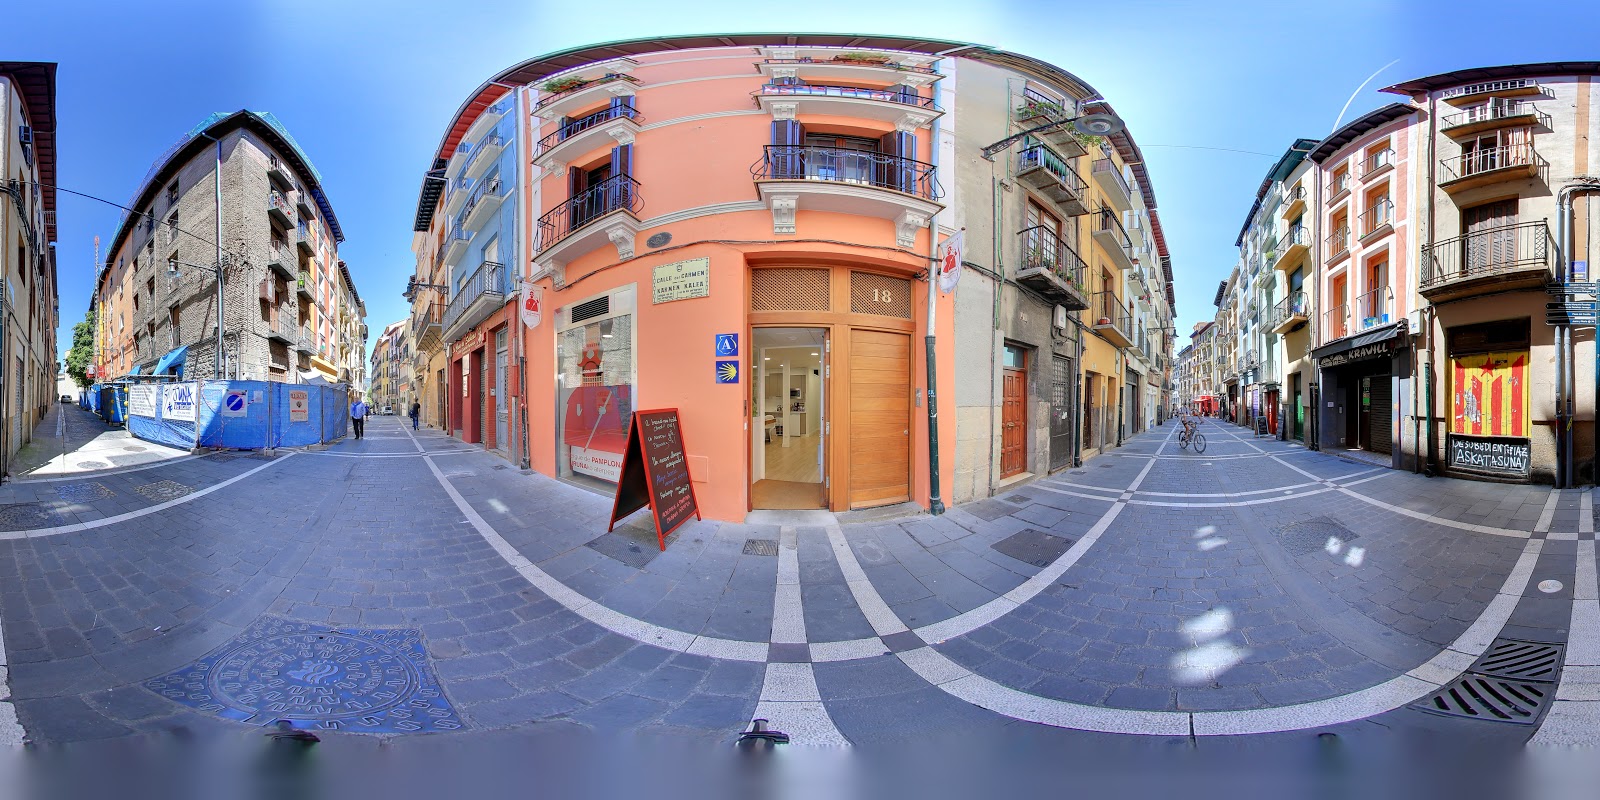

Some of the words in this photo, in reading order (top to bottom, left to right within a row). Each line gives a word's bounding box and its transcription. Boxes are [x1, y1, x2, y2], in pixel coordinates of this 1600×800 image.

[656, 275, 672, 284] CALLE
[681, 271, 705, 279] CARMEN
[873, 288, 892, 303] 18
[721, 338, 732, 350] A
